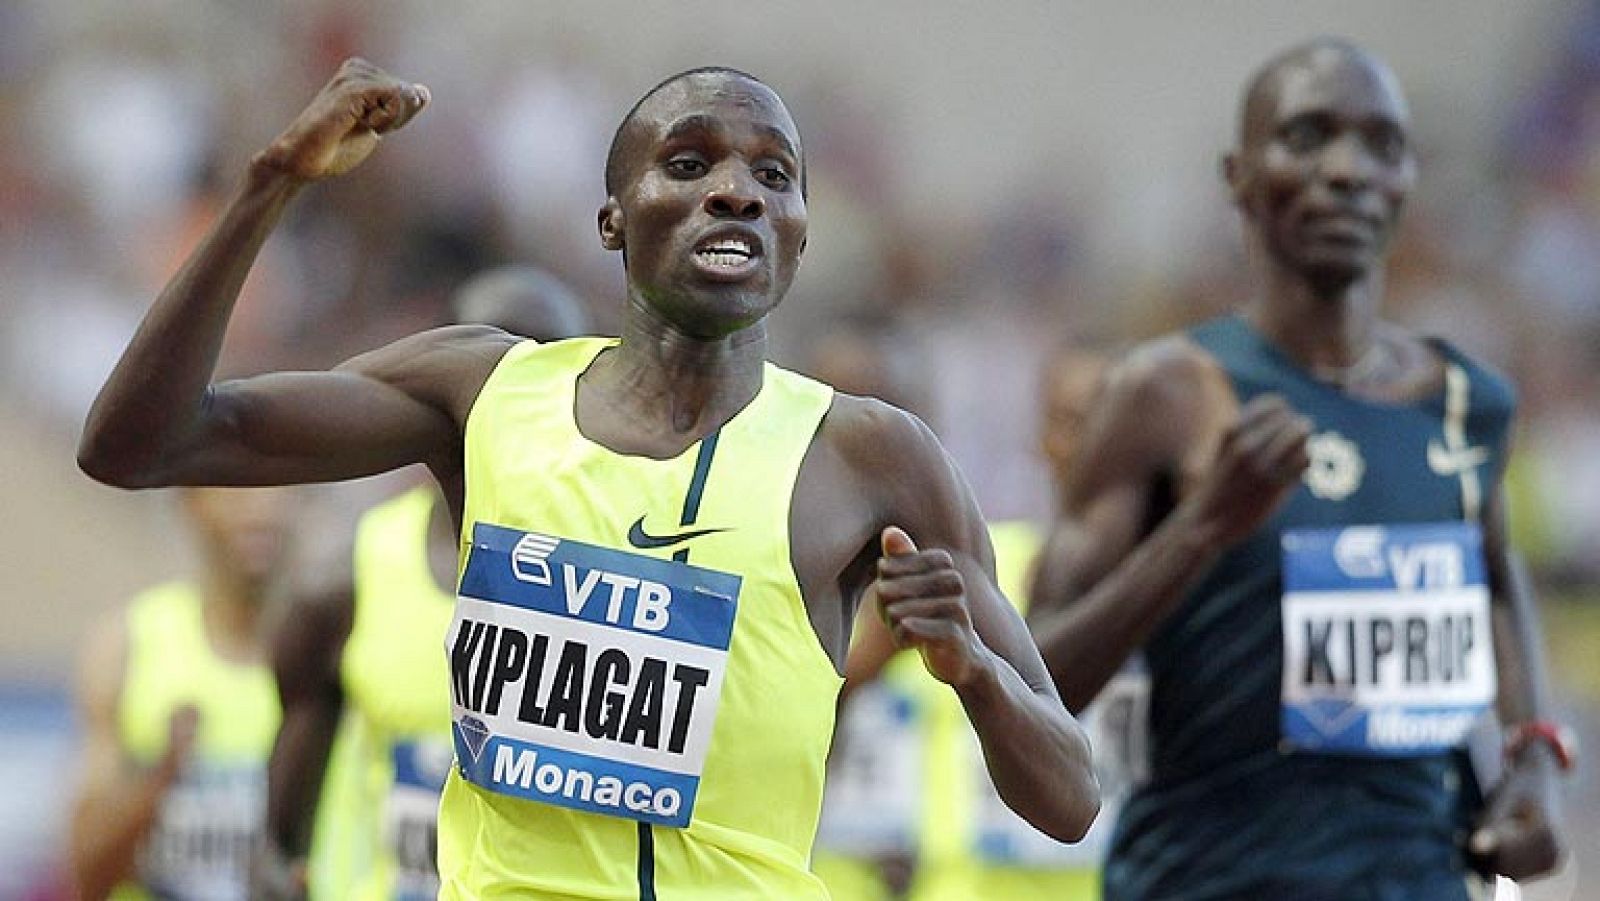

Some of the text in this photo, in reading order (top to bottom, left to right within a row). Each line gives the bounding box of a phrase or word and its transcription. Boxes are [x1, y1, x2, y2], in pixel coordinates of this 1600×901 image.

[562, 564, 672, 631] VTB
[1303, 615, 1475, 686] KIPROP
[451, 619, 710, 754] KIPLAGAT
[492, 744, 681, 816] Monaco
